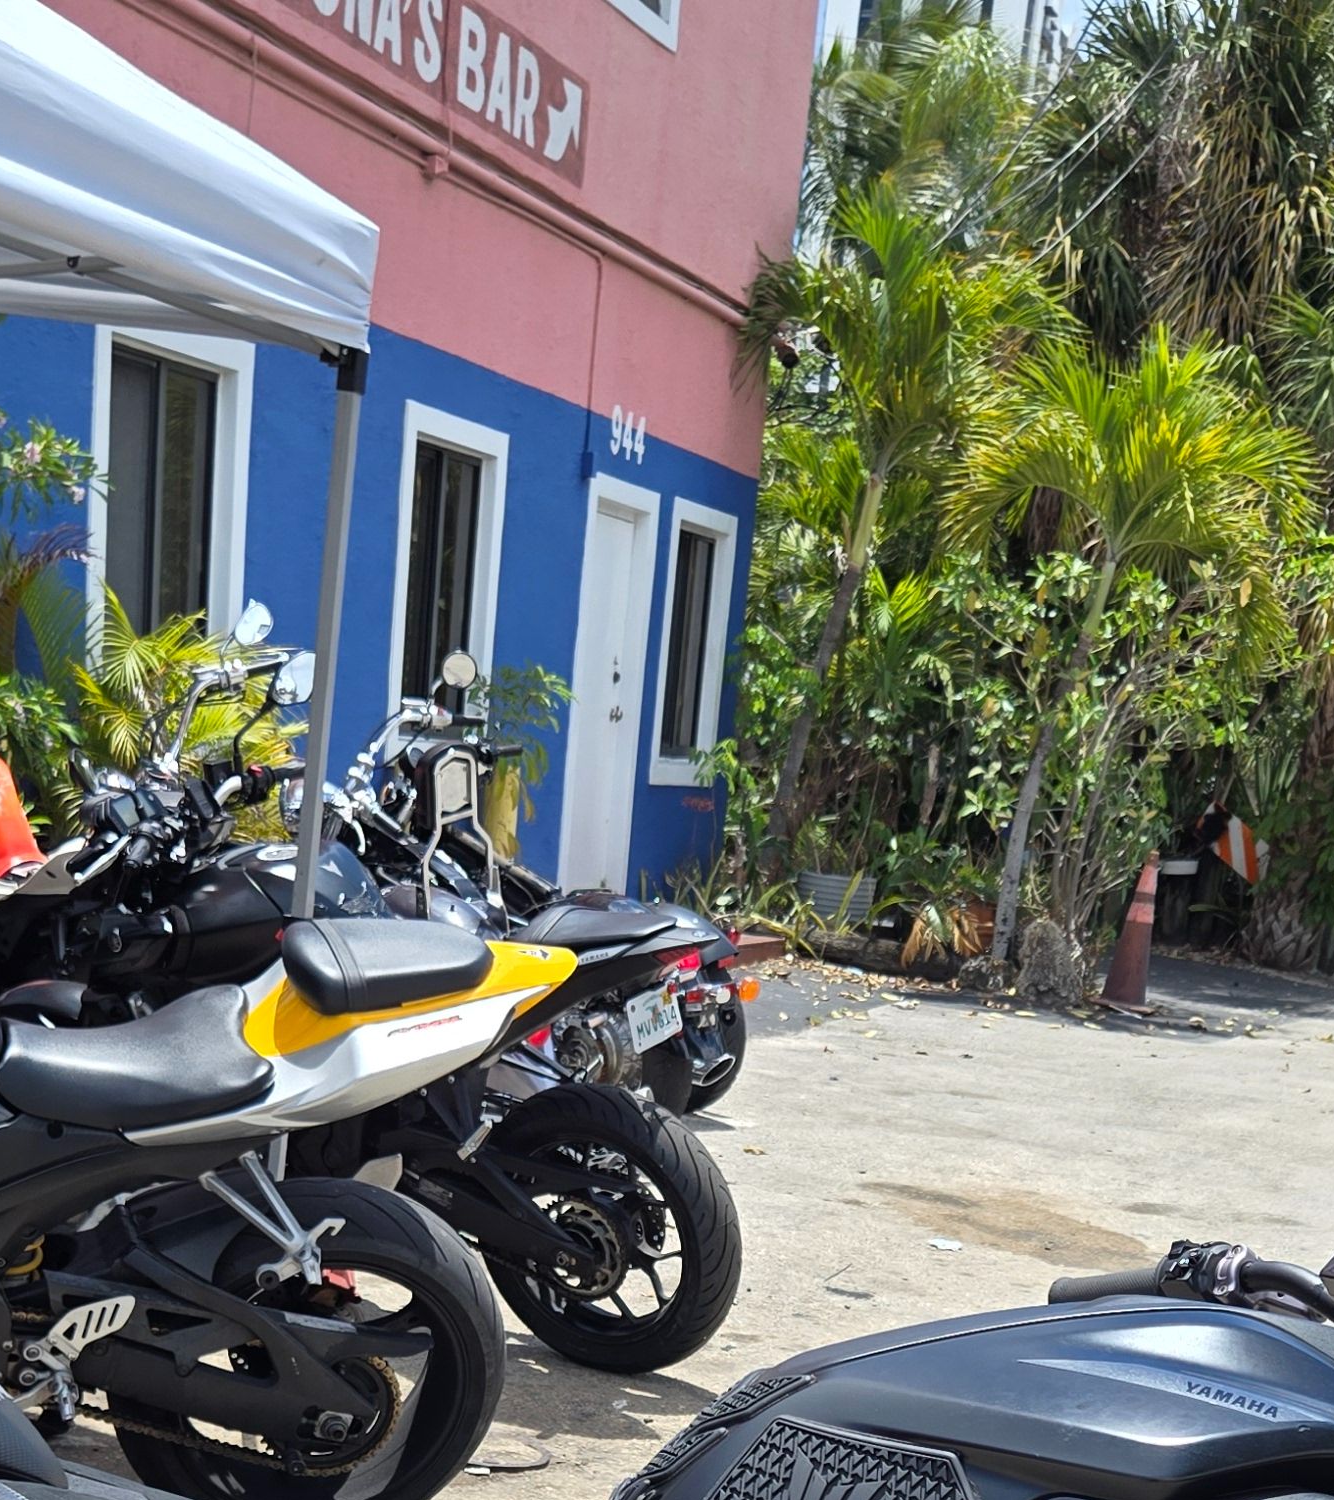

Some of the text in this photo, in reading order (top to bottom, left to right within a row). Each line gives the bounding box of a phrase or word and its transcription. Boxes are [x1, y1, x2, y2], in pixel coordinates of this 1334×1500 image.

[457, 5, 540, 149] BAR
[610, 404, 647, 465] 944
[1186, 1381, 1279, 1418] YAMAHA
